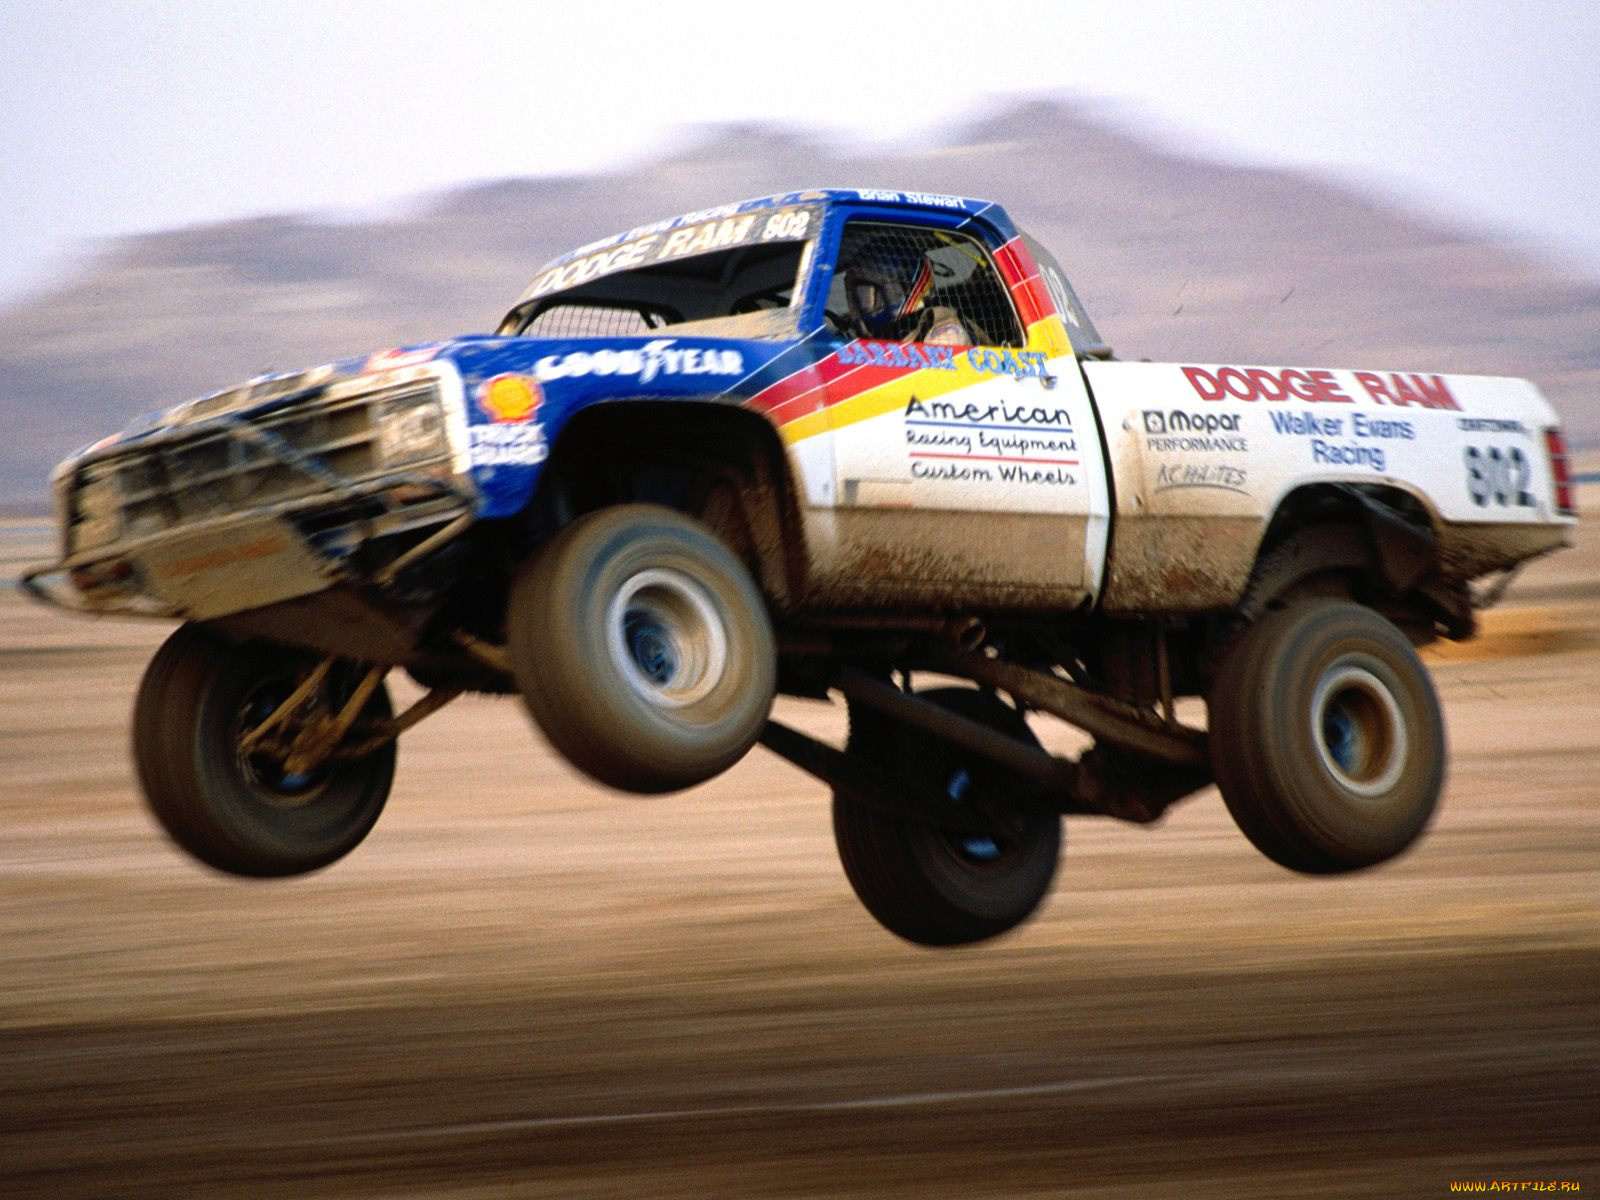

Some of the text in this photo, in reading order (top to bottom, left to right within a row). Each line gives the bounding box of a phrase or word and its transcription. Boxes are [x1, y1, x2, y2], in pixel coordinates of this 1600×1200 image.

[904, 191, 967, 208] Stewart
[531, 238, 657, 298] DODGE
[658, 215, 754, 259] RAM
[534, 340, 744, 384] GOODYEAR
[967, 350, 1050, 378] COAST
[1181, 366, 1463, 411] DODGE RAM
[905, 396, 1071, 426] American
[1169, 410, 1242, 435] Mopar
[1270, 411, 1416, 440] Walker Evans
[907, 431, 1077, 455] Racing Equipment
[1147, 437, 1249, 452] PERFORMANCE
[1313, 440, 1385, 471] Racing
[912, 461, 1076, 486] Custom Wheels
